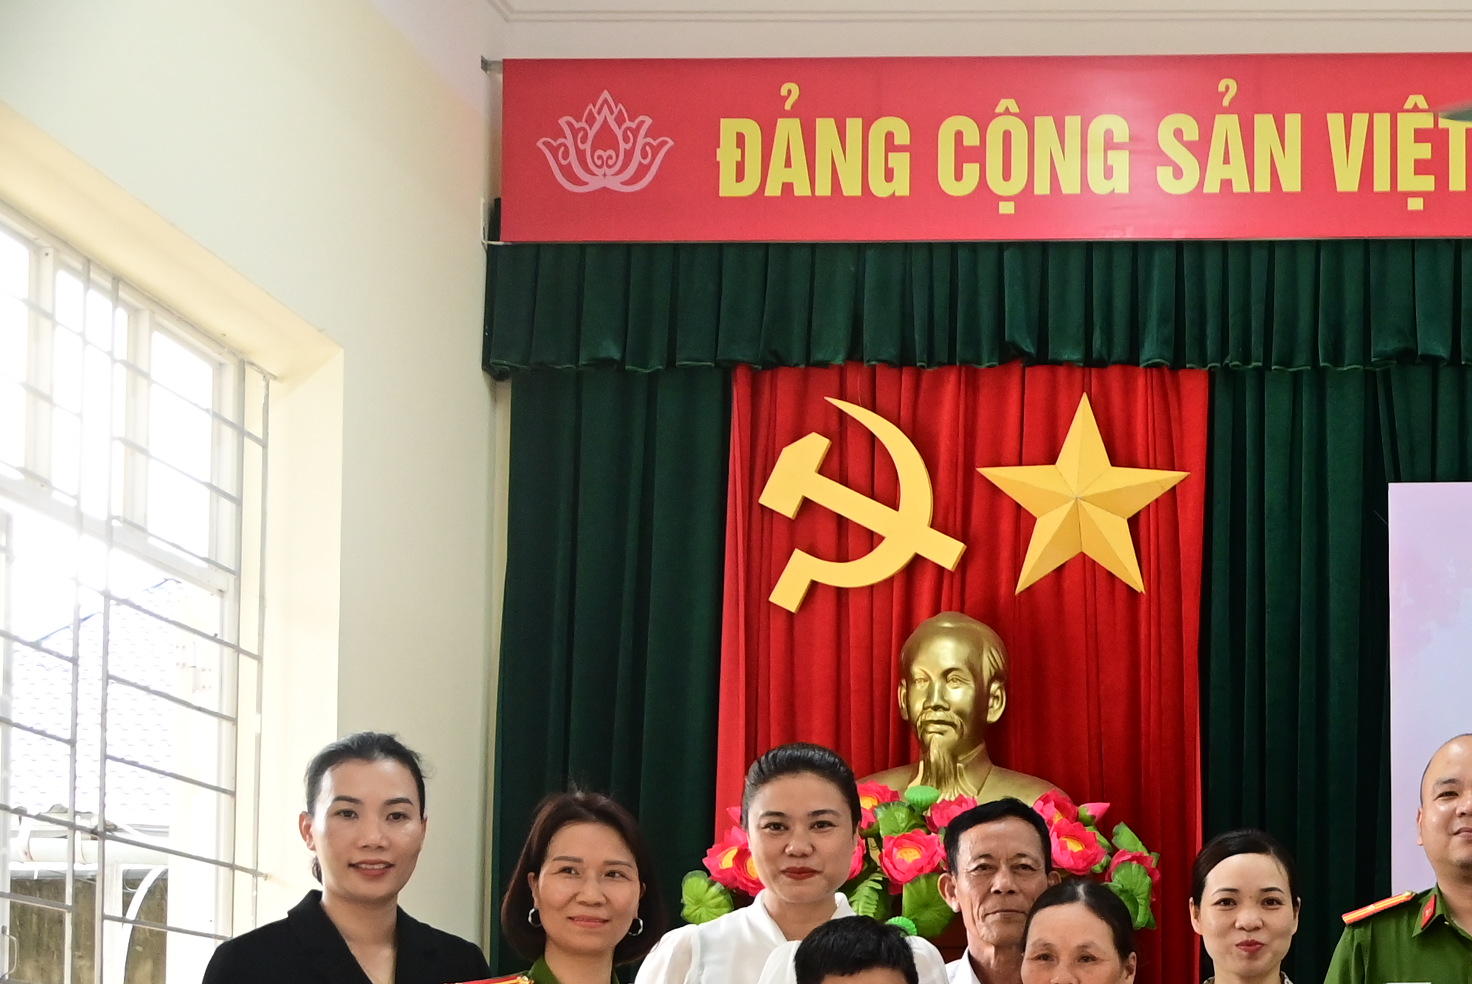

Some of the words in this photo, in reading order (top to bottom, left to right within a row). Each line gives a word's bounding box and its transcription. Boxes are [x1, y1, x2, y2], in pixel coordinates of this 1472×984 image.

[716, 82, 910, 198] ĐẢNG
[937, 99, 1130, 214] CỘNG
[1156, 78, 1302, 195] SẢN
